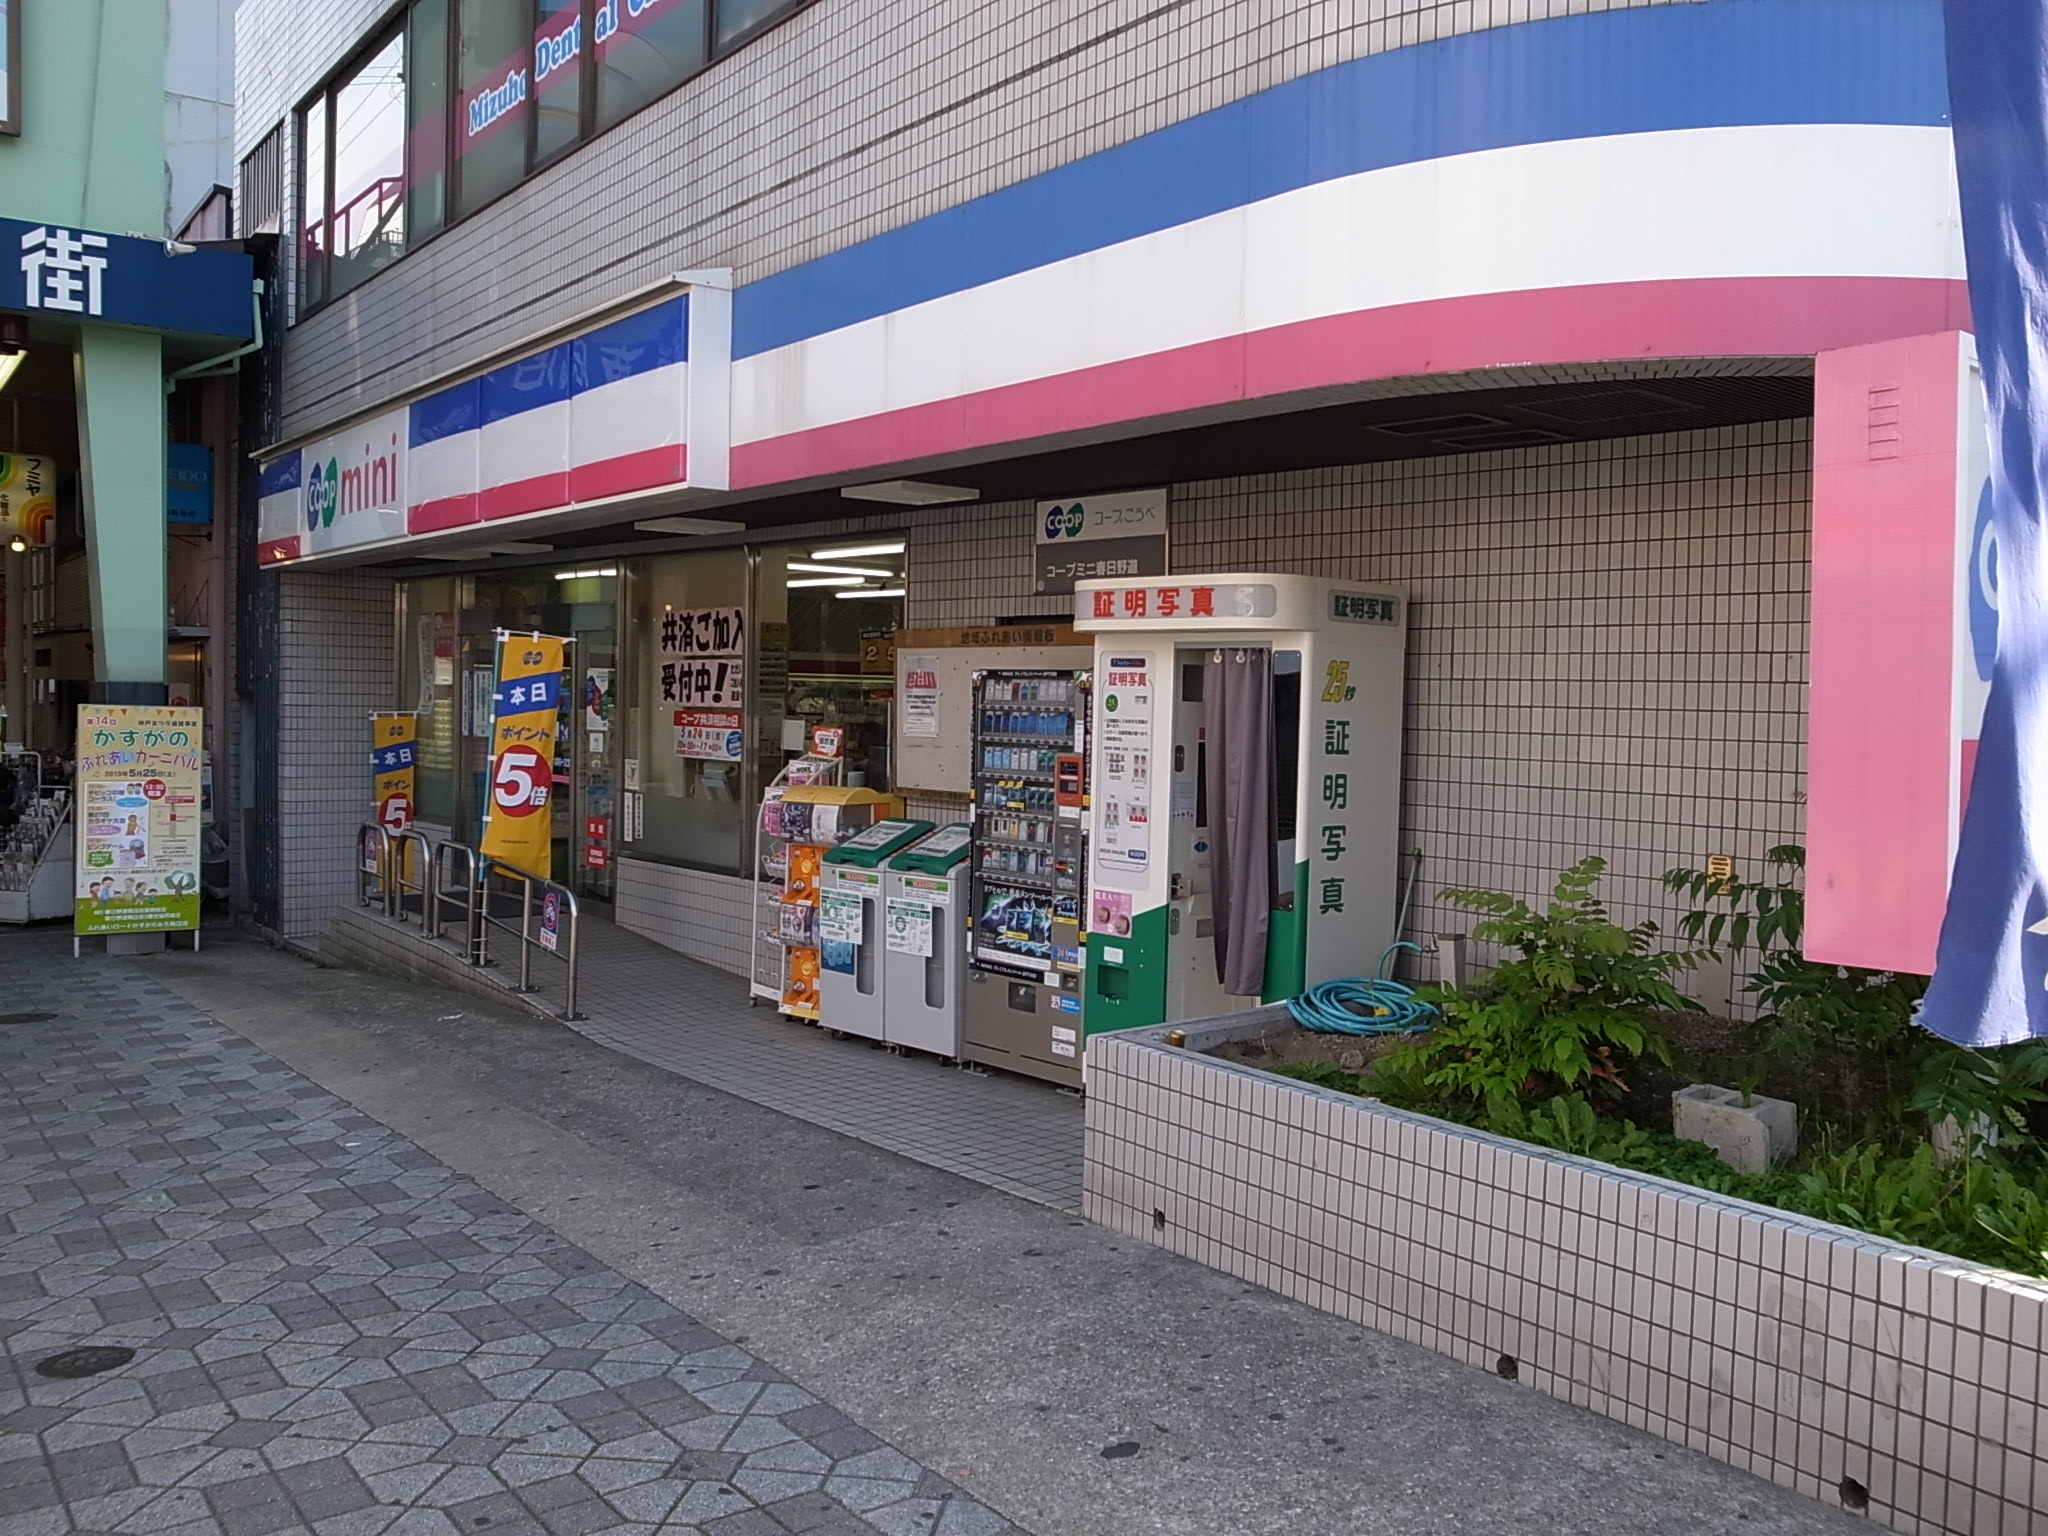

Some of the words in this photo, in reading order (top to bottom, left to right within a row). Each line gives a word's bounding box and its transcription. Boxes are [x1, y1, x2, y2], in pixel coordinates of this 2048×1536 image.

[20, 226, 107, 316] 街
[26, 457, 42, 497] フミヤ
[341, 432, 397, 516] mini
[1093, 506, 1156, 526] コープこうべ
[1046, 559, 1139, 578] コープミニ春日野道
[1093, 586, 1215, 618] 証明写真
[1333, 594, 1394, 622] 証明写真
[661, 609, 743, 653] 共済ご加入
[661, 661, 729, 704] 受付中!
[1108, 671, 1148, 687] 証明写真
[510, 682, 547, 706] 本日
[93, 728, 189, 748] かすがの
[501, 726, 550, 743] ポイント
[81, 749, 199, 771] ふれあいカーニバル
[384, 747, 413, 766] 本日
[1318, 719, 1350, 915] 証明写真
